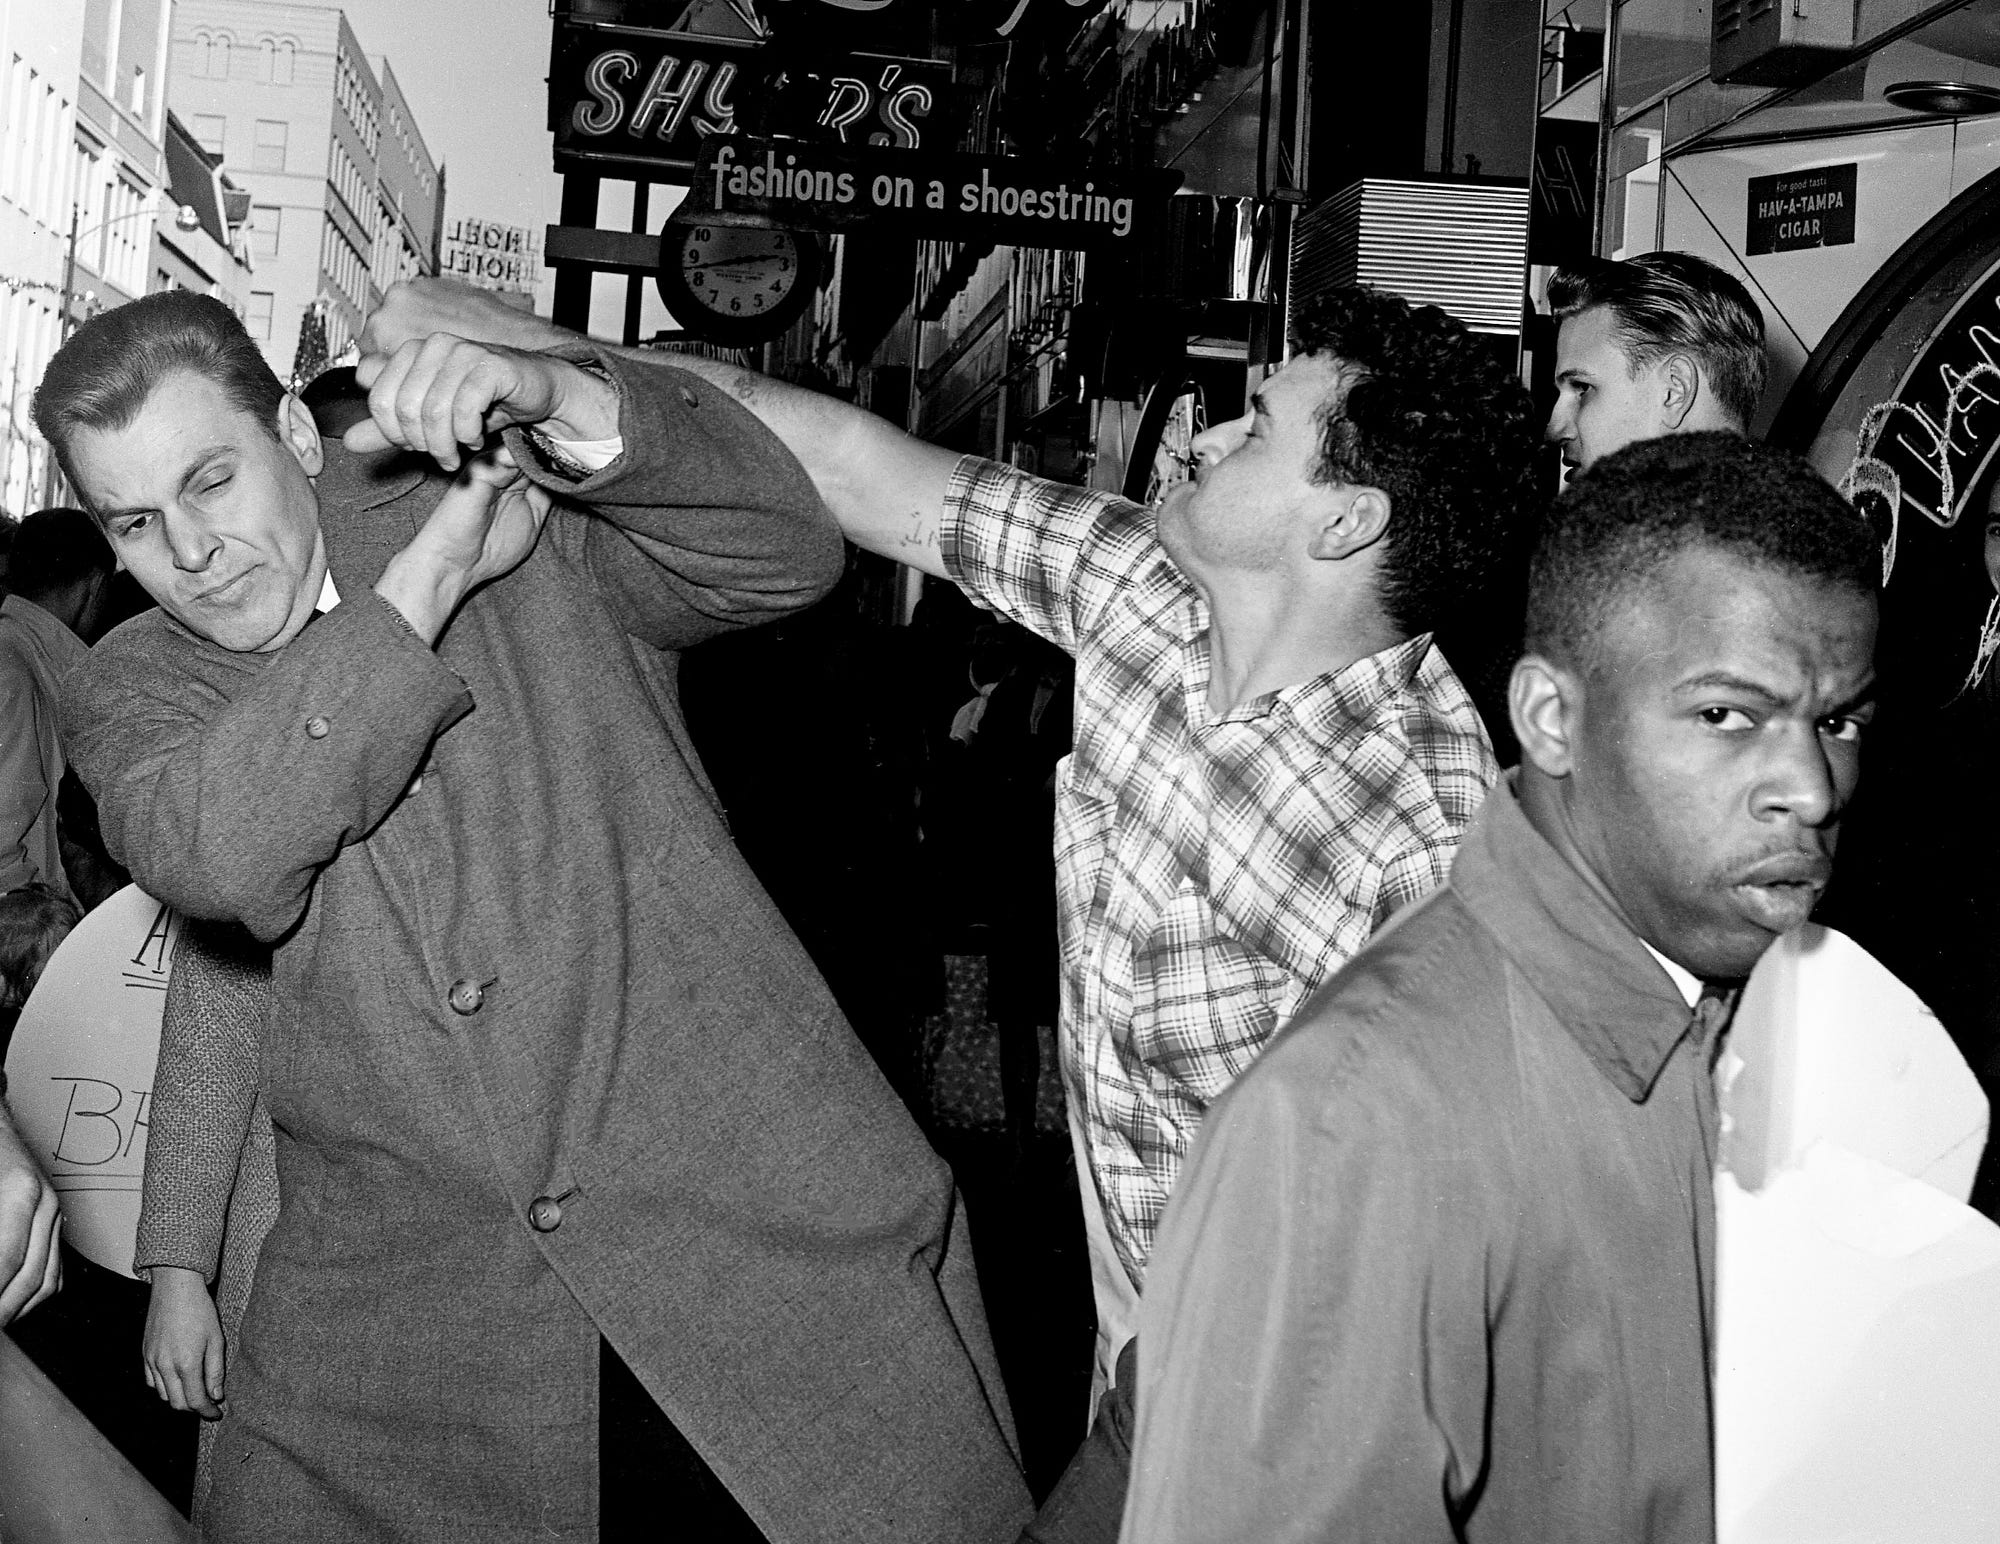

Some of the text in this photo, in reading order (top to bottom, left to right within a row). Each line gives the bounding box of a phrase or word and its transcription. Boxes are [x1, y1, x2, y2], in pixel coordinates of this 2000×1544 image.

[572, 50, 932, 150] SHYR'S
[710, 146, 1133, 237] fashions on a shoestring
[1789, 179, 1807, 194] good
[1759, 191, 1844, 219] HAV-A-TAMPA
[694, 228, 711, 242] 10
[1779, 219, 1821, 239] CIGAR
[774, 234, 786, 250] 2
[688, 249, 700, 264] 9
[778, 257, 790, 272] 3
[693, 271, 705, 287] 8
[768, 279, 782, 293] 4
[709, 289, 719, 304] 7
[730, 296, 741, 312] 6
[753, 293, 764, 308] 5
